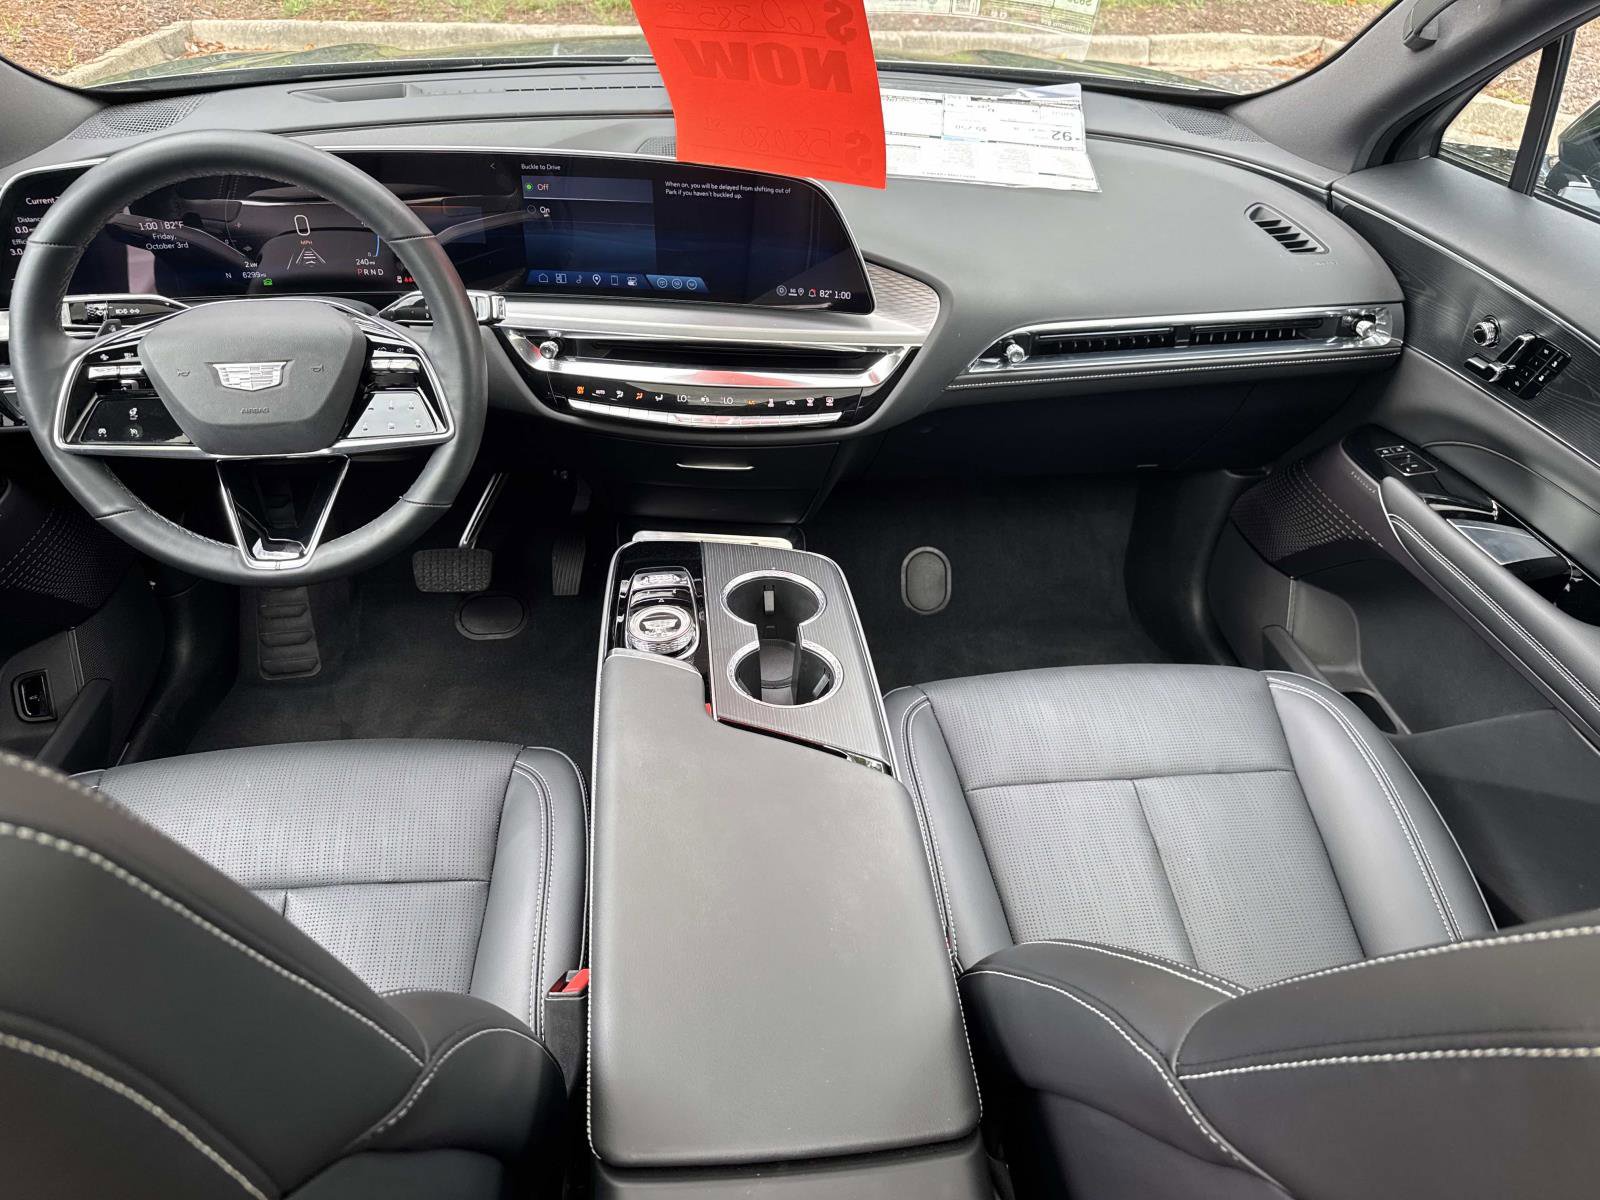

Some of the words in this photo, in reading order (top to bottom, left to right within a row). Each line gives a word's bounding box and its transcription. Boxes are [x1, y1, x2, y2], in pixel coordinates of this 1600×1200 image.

[521, 163, 539, 171] Buckle
[547, 163, 561, 171] Drive
[537, 183, 549, 191] Off
[719, 184, 740, 192] delayed
[754, 186, 775, 195] shifting
[713, 191, 734, 199] buckled
[25, 196, 56, 205] Current
[539, 206, 551, 214] On
[16, 216, 42, 224] Distanc
[139, 222, 158, 231] 1:00
[146, 242, 175, 251] October
[176, 241, 190, 250] 3rd
[834, 291, 852, 300] 1:00
